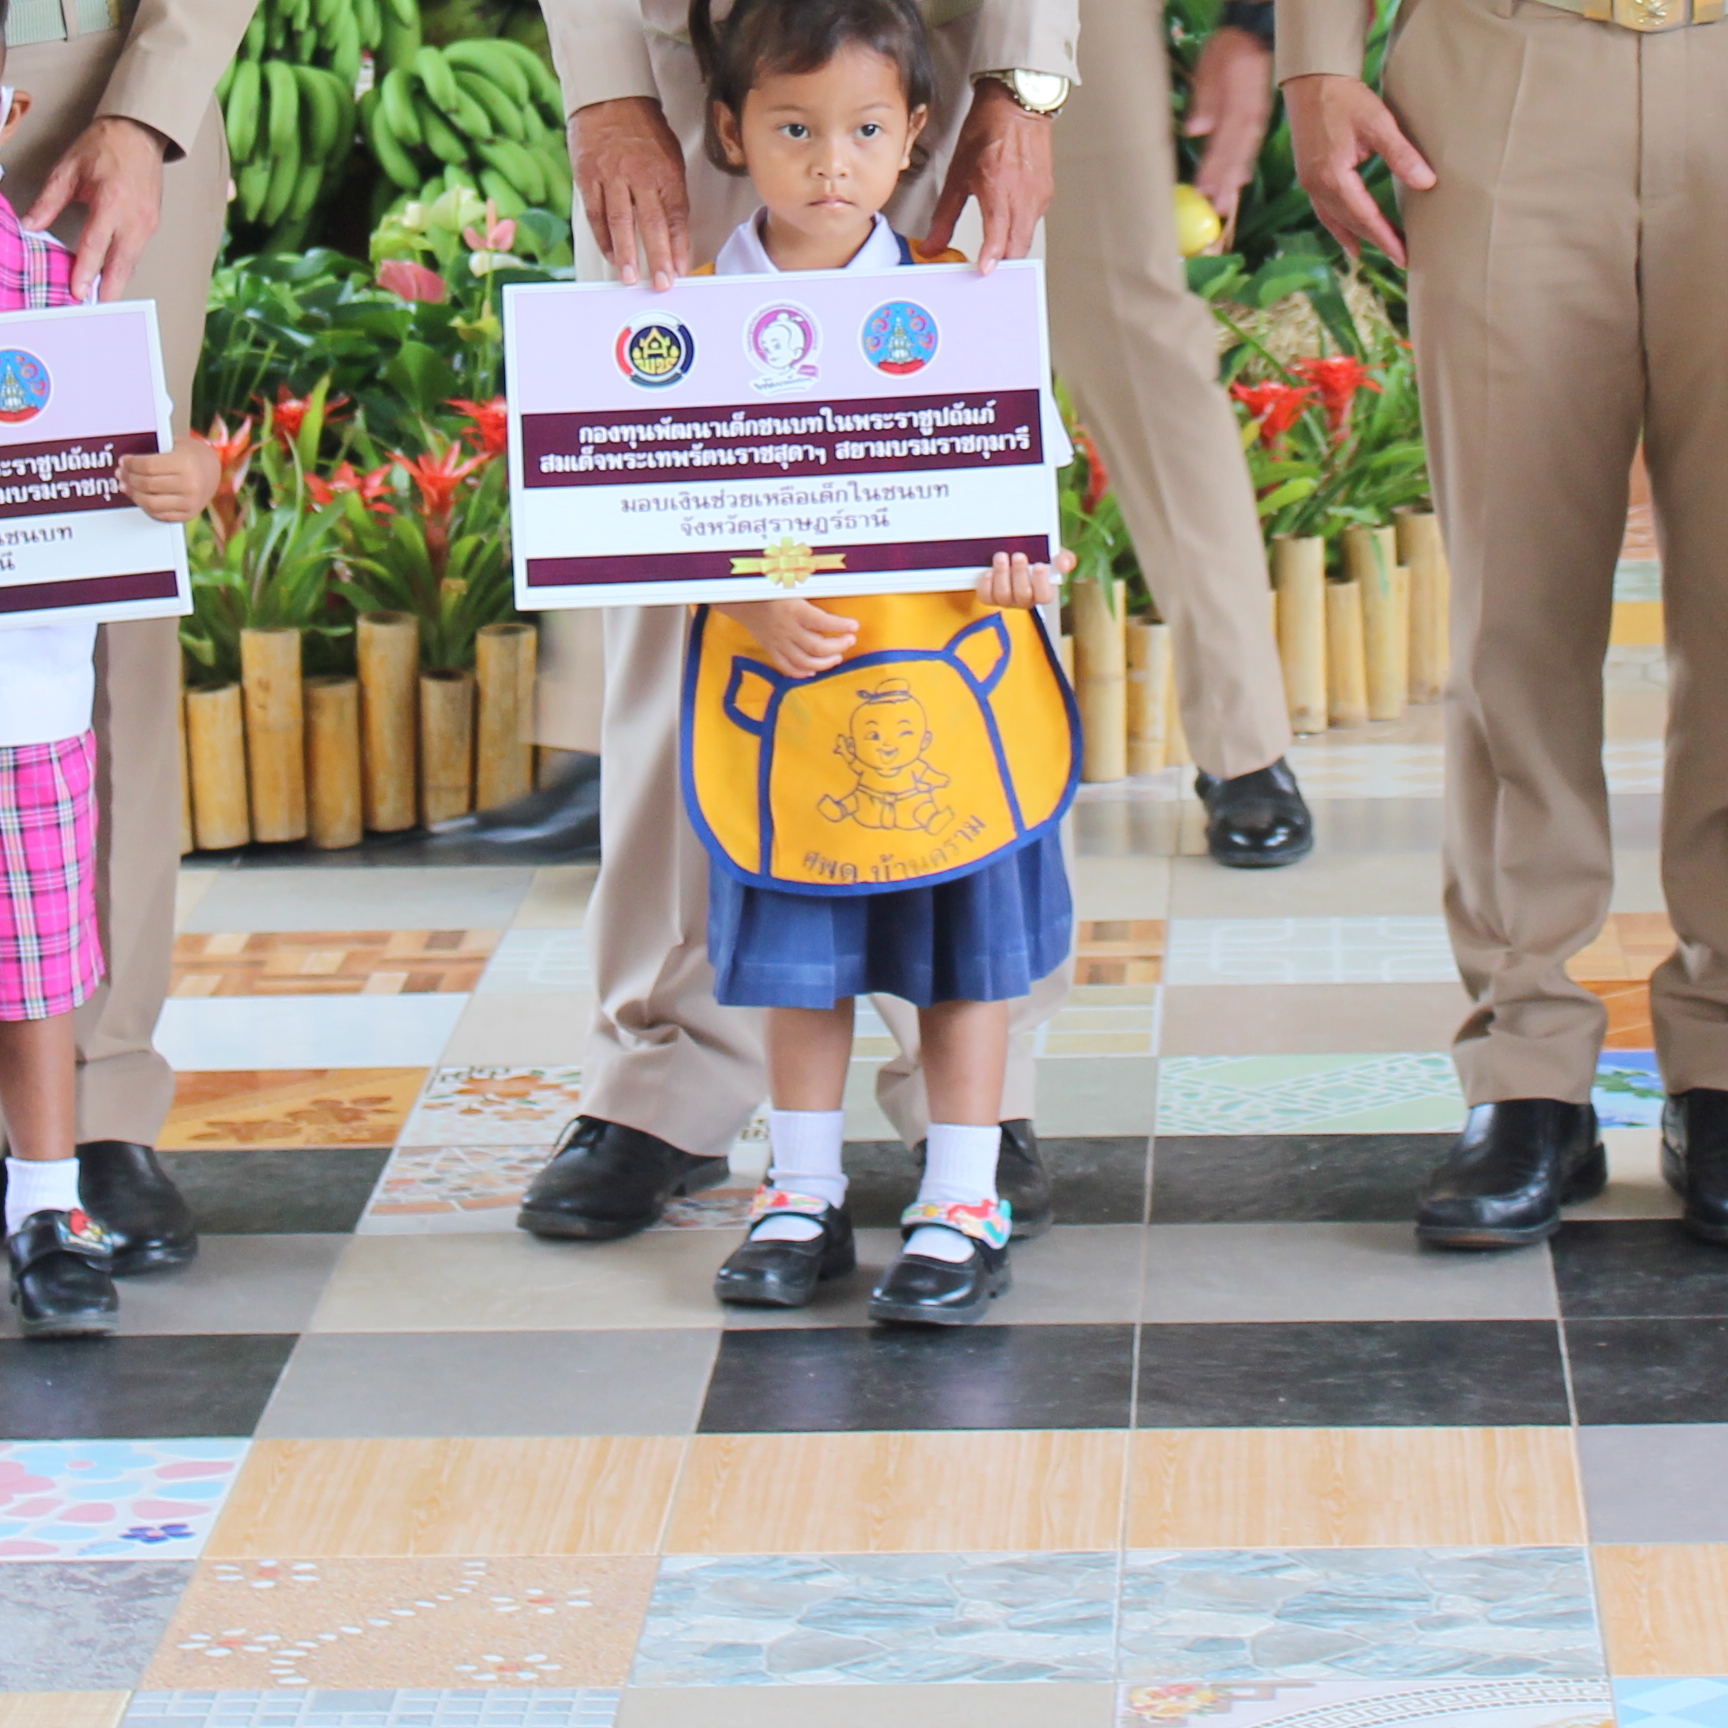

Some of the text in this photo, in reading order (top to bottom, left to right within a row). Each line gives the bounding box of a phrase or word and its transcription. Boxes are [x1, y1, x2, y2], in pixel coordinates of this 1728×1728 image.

[579, 399, 996, 444] กองทุนพัฒนาเด็กชนบทในพระราชูปถัมภ์
[834, 424, 1030, 461] สยามบรมราชกุมารี
[621, 479, 949, 514] มอบเงินช่วยเหลือเด็กในชนบท
[679, 507, 890, 537] จังหวัดสุราษฎร์ธานี
